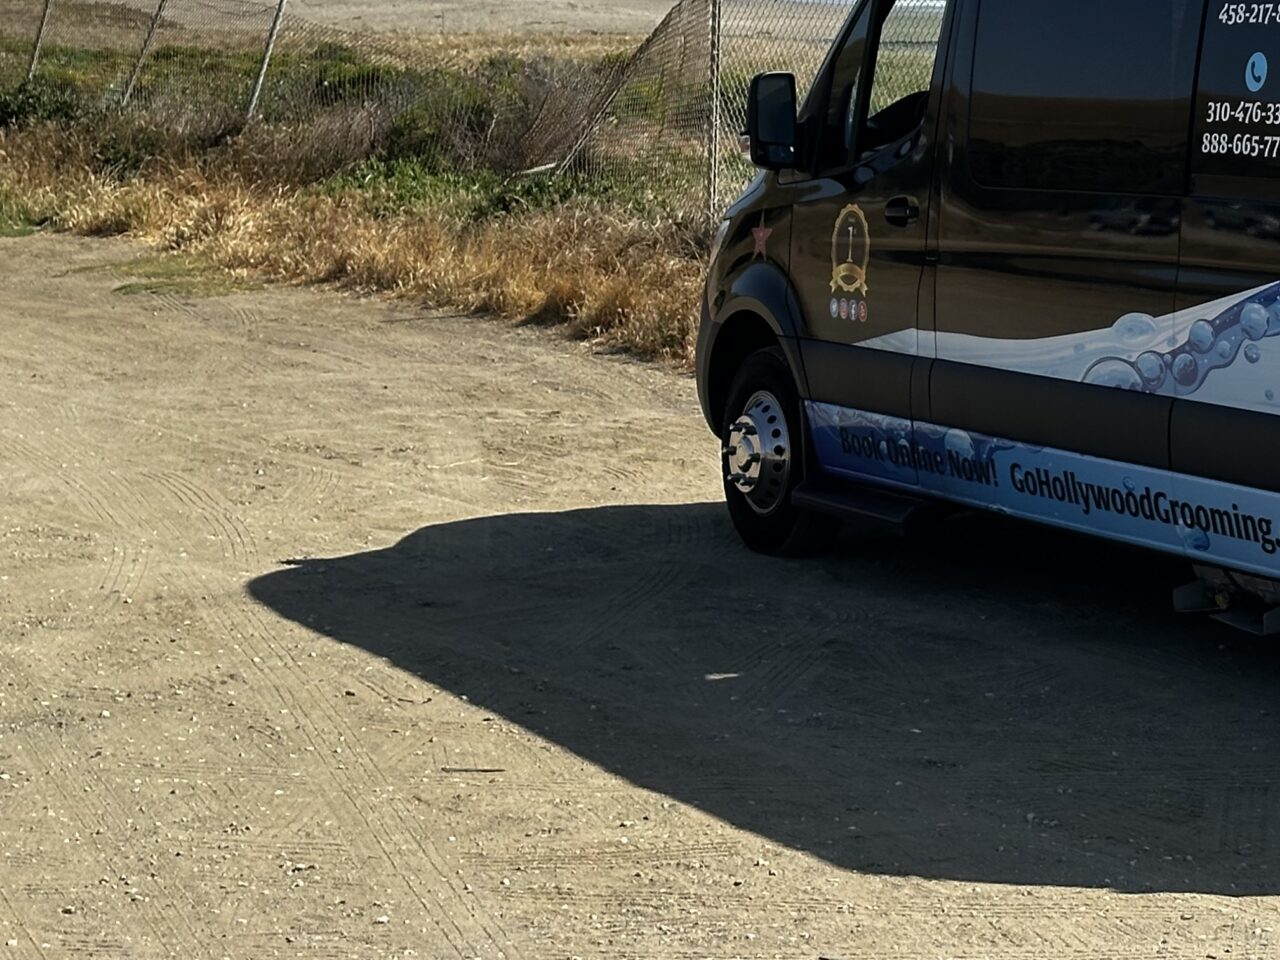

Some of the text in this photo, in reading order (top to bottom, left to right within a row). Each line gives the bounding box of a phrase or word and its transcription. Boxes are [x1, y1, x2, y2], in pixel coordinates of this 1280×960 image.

[839, 426, 884, 462] Book
[886, 439, 946, 475] Online
[947, 448, 999, 487] Now!
